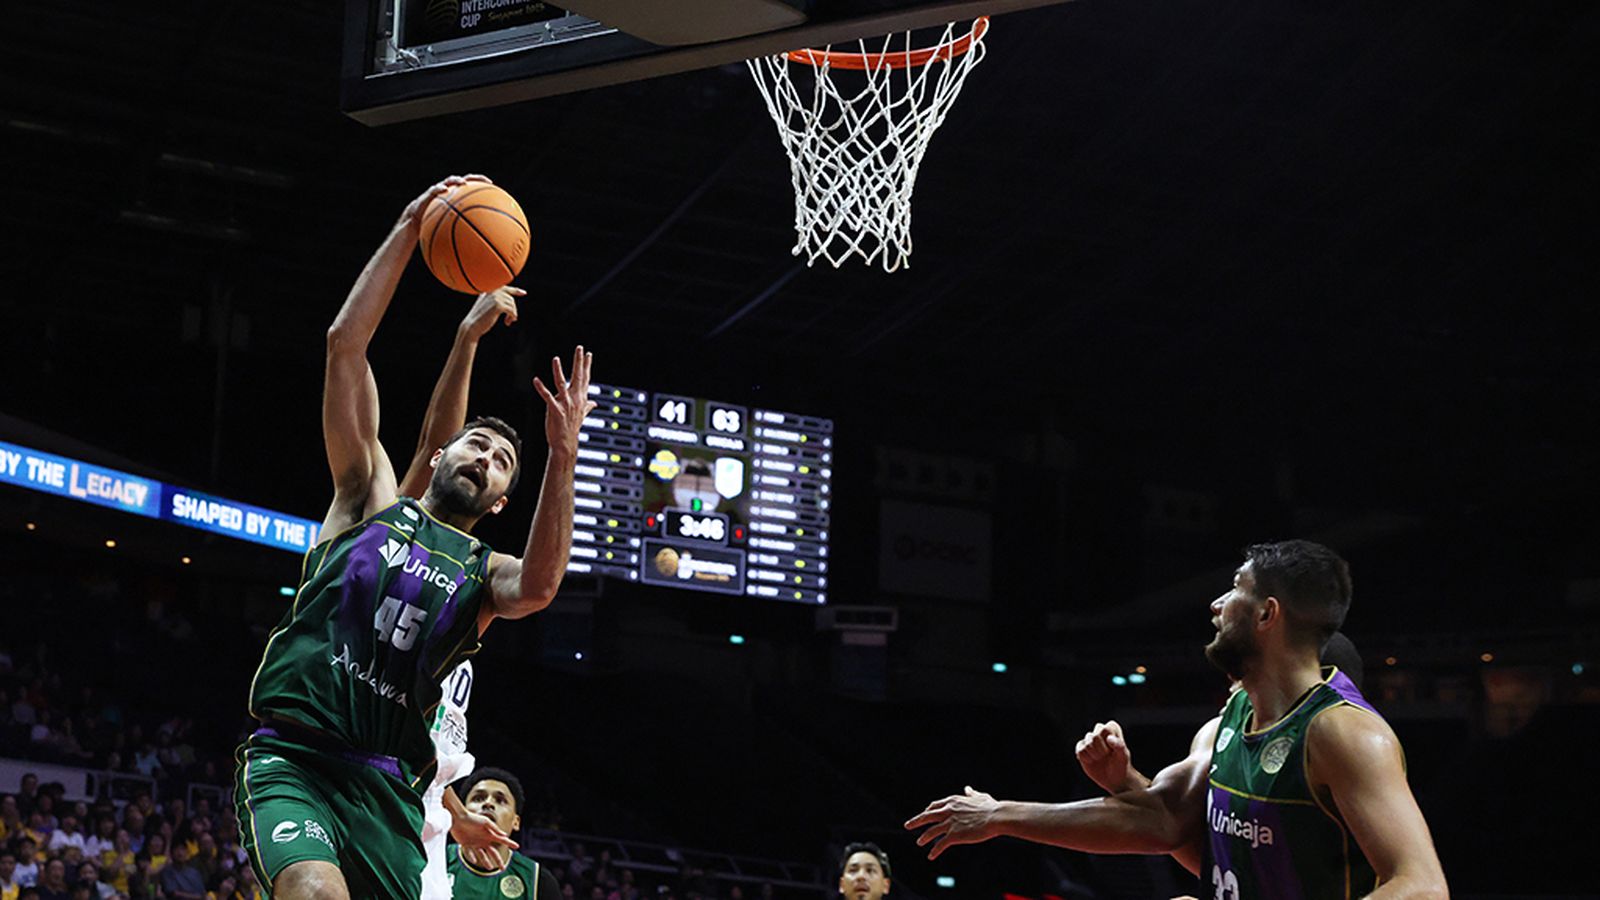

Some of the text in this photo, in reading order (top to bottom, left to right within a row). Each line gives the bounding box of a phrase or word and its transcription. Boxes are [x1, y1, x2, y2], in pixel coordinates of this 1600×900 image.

[461, 13, 481, 28] CUP
[659, 400, 686, 424] 41
[712, 409, 740, 433] 63
[26, 456, 66, 488] THE
[172, 493, 243, 531] SHAPED
[245, 511, 271, 537] BY
[273, 518, 306, 547] THE
[680, 515, 724, 540] 3:46
[374, 596, 428, 651] 45
[1212, 808, 1273, 849] Unicaja
